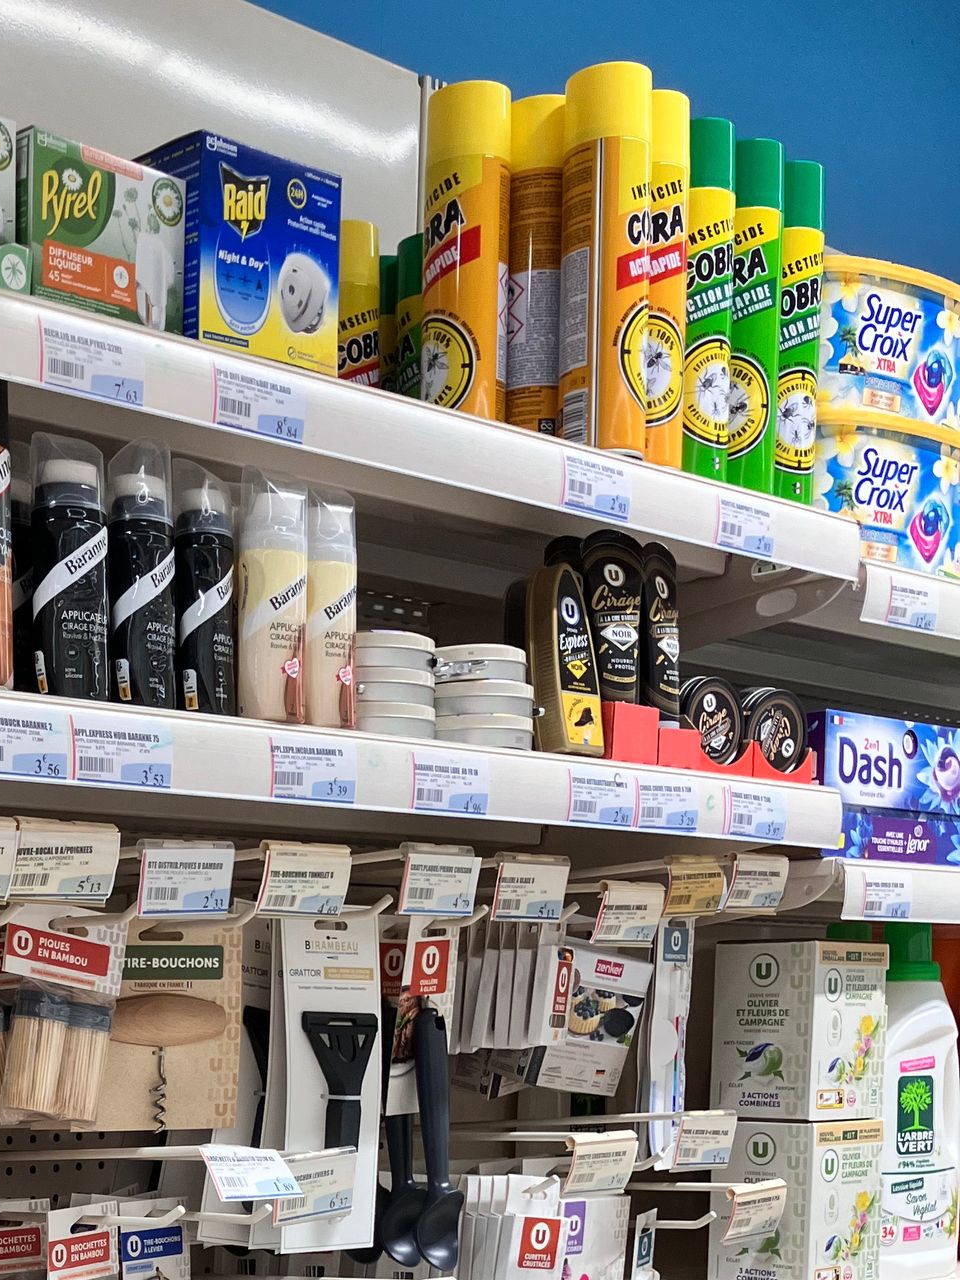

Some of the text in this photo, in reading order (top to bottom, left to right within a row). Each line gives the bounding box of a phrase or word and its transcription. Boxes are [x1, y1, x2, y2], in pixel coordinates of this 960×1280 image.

[42, 170, 103, 222] Pyrel
[224, 183, 266, 222] Raid
[49, 247, 93, 266] DIFFUSEUR
[218, 249, 265, 272] Night Day
[49, 257, 81, 273] LIQUIDE
[862, 294, 922, 336] Super
[856, 318, 913, 358] Croix
[877, 358, 897, 374] XTRA
[857, 449, 918, 484] Super
[855, 478, 908, 513] Croix
[873, 511, 893, 526] XTRA
[610, 629, 633, 641] NOIR
[559, 633, 589, 653] Express
[840, 737, 902, 790] Dash
[40, 938, 70, 952] PIQUES
[305, 938, 359, 951] BIRAMBEAU
[38, 947, 88, 966] EN BAMBOU
[123, 956, 219, 969] TIRE-BOUCHONS
[289, 968, 321, 977] GRATTOIR
[595, 959, 623, 976] zenker
[747, 999, 779, 1008] OLIVIER
[747, 1009, 777, 1017] FLEURS
[739, 1018, 785, 1027] CAMPAGNE
[748, 1092, 779, 1101] ACTIONS
[897, 1131, 933, 1142] L'ARBRE
[897, 1140, 933, 1153] VERT
[0, 1243, 32, 1254] BAMBOU
[70, 1238, 107, 1253] BROCHETTES
[81, 1247, 104, 1259] BAMBOU
[525, 1252, 546, 1261] CURETTE
